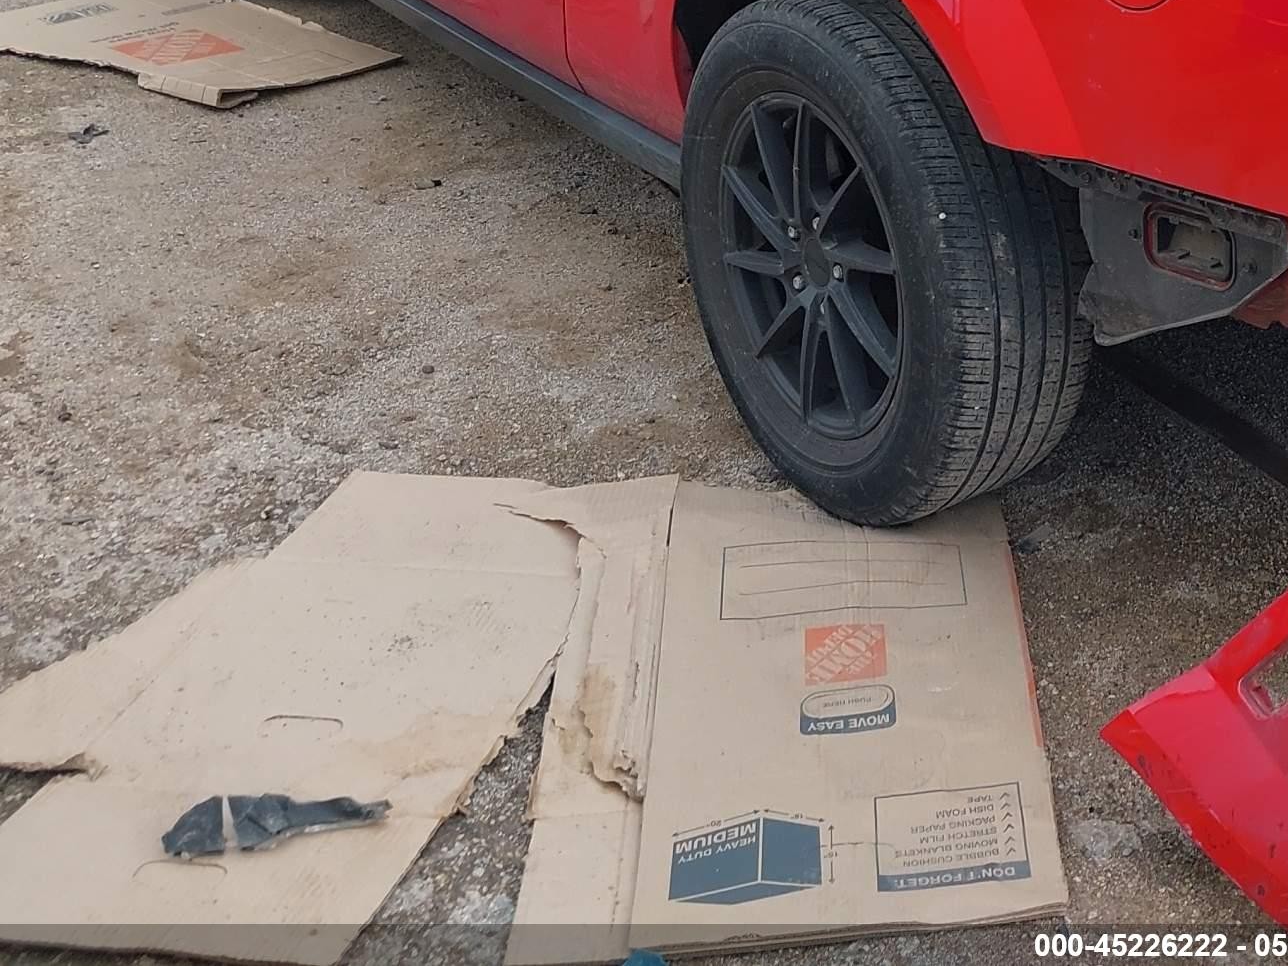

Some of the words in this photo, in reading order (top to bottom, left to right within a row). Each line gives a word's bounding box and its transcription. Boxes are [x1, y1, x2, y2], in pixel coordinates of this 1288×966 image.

[808, 720, 844, 731] EASY
[848, 714, 890, 728] MOVE
[967, 794, 993, 803] TAPE
[936, 808, 966, 818] FOAM
[969, 804, 994, 813] DISH
[948, 815, 995, 828] PACKING
[910, 823, 945, 834] PAPER
[948, 826, 997, 839] STRETCH
[675, 822, 756, 854] MEDIUM
[919, 834, 944, 843] FILM
[955, 838, 998, 850] MOVING
[716, 835, 756, 854] HEAVY
[678, 850, 712, 864] DUTY
[895, 844, 952, 859] BLANKETS
[956, 848, 999, 860] BUBBLE
[903, 855, 952, 867] CUSHION
[968, 866, 1015, 879] DON'T
